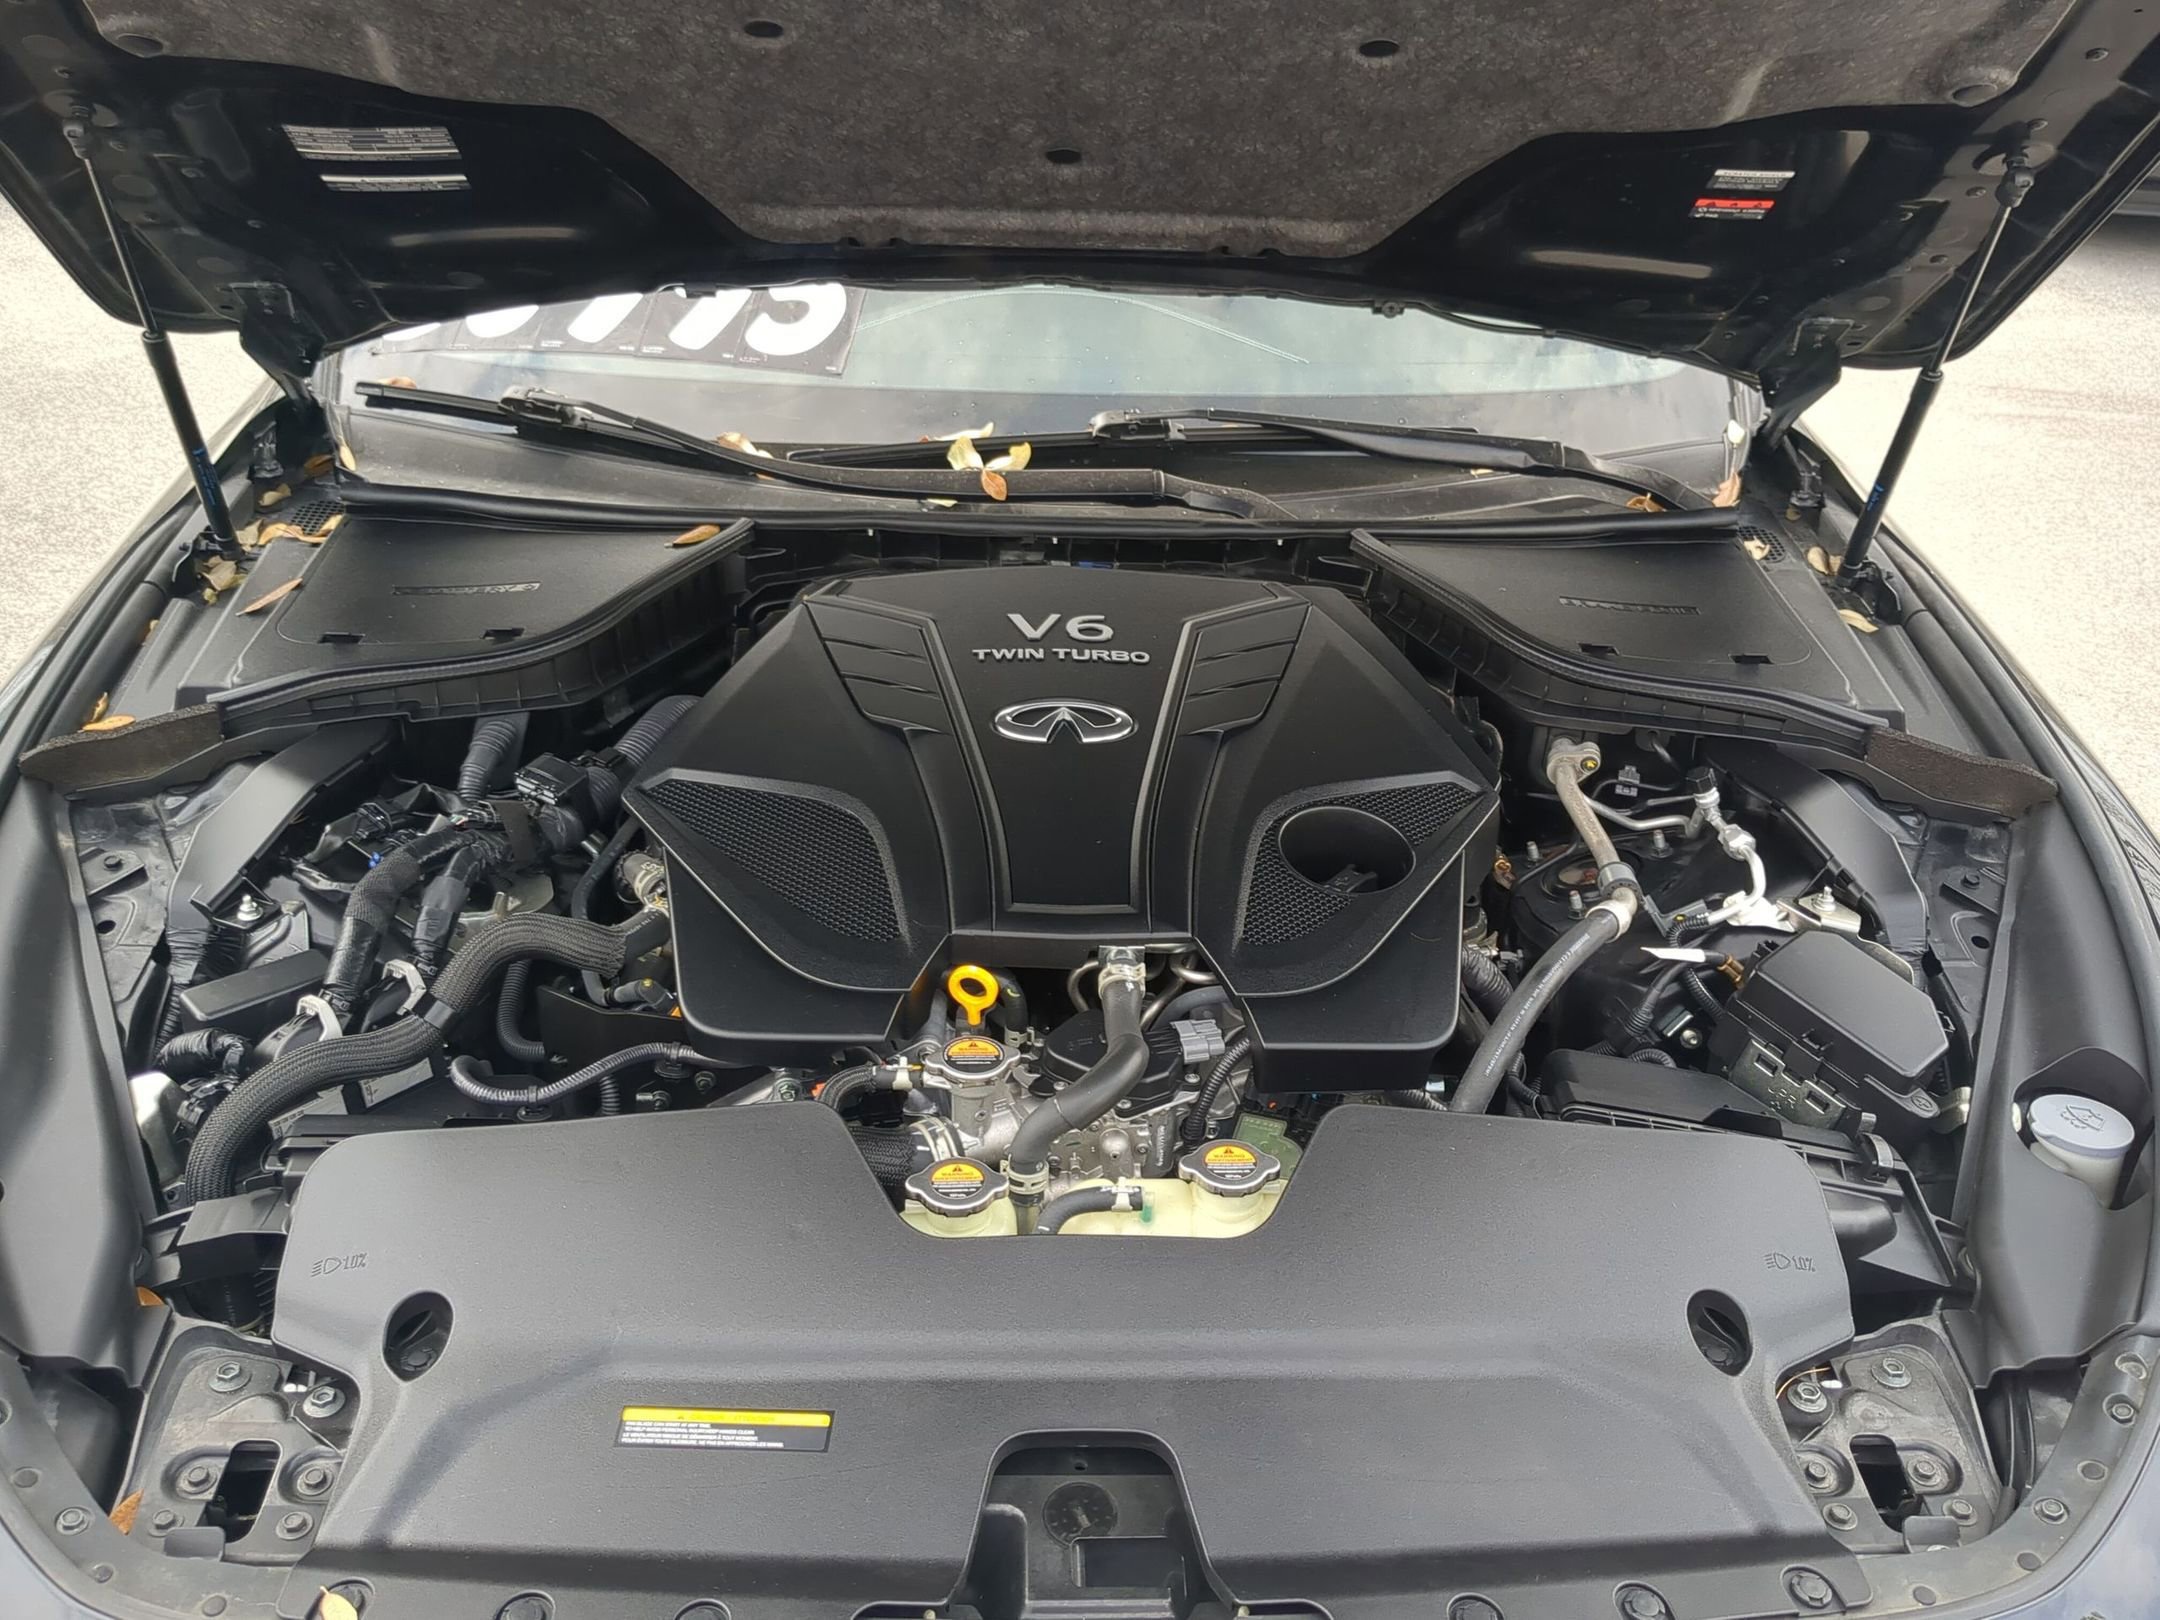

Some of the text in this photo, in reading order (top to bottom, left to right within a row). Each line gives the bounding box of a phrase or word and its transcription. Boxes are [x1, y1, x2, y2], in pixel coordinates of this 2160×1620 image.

[1007, 613, 1114, 642] V6
[972, 648, 1151, 664] TWIN TURBO
